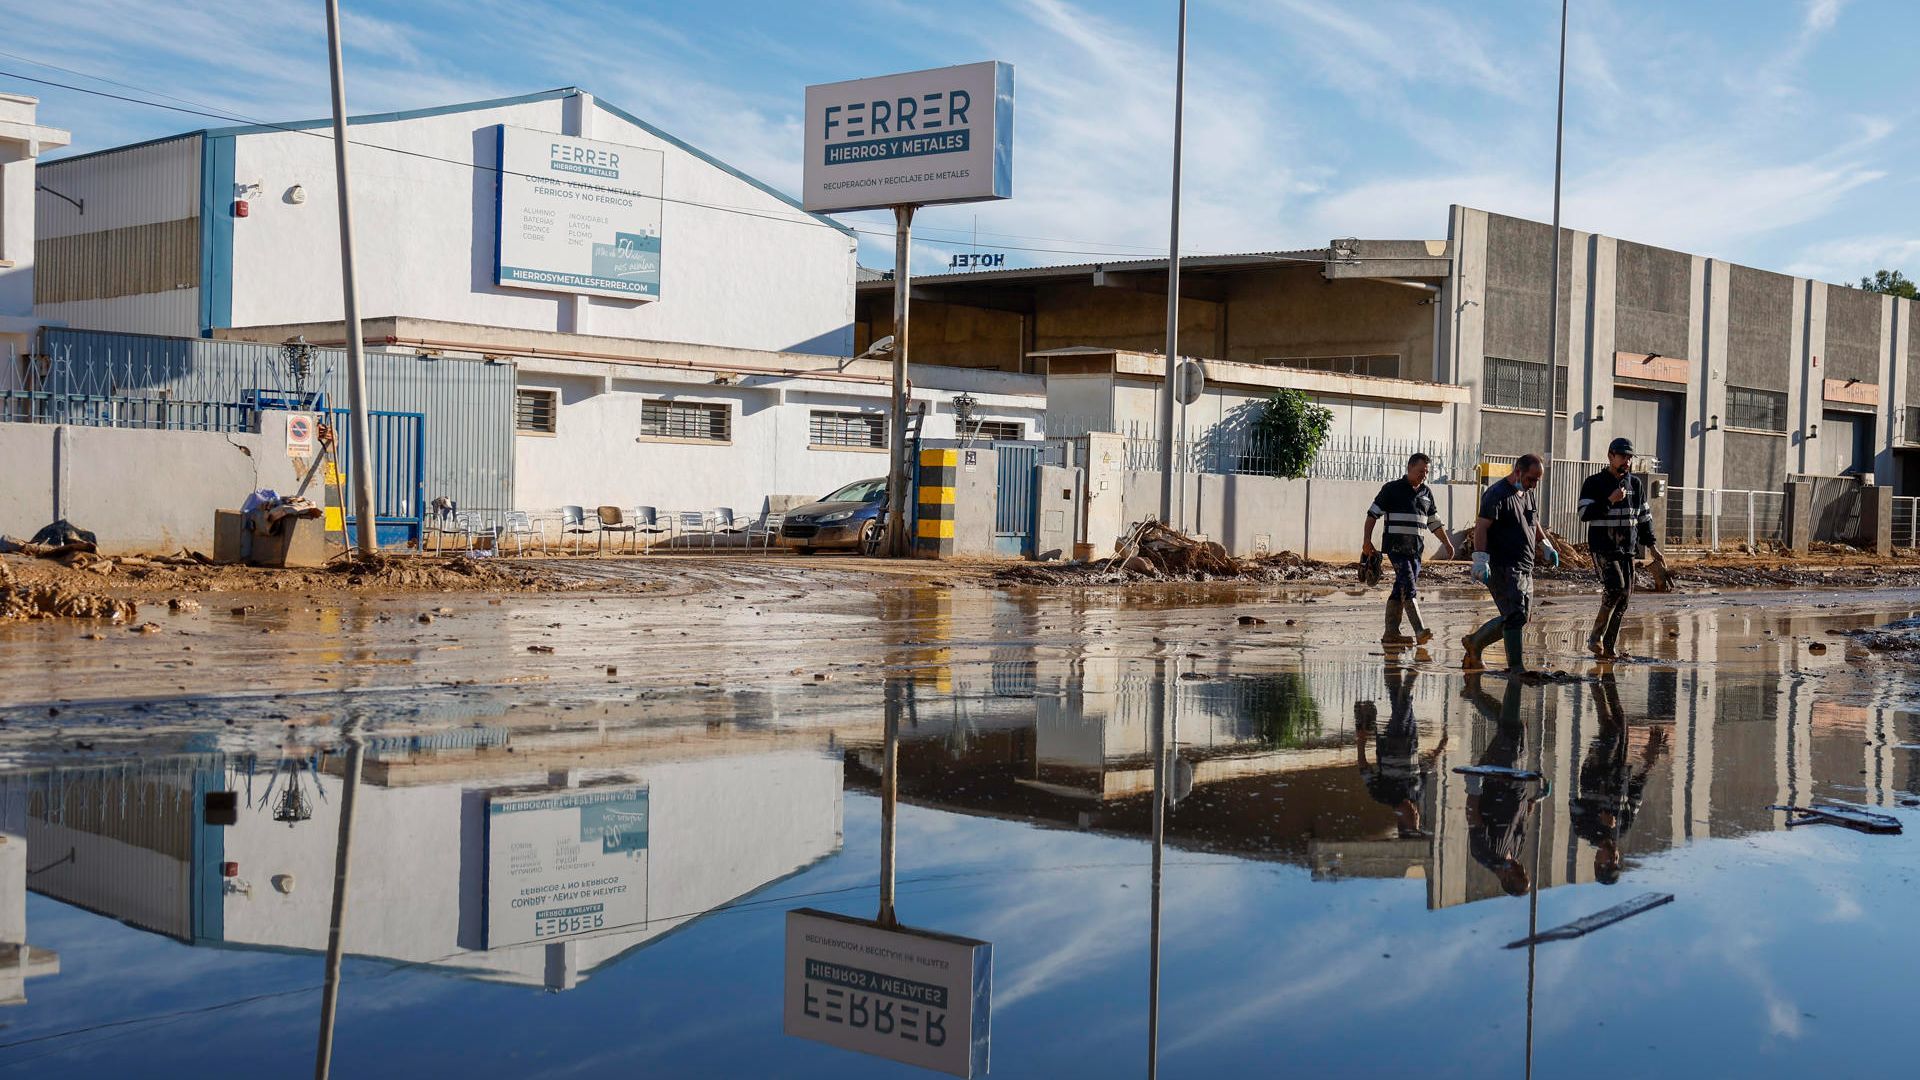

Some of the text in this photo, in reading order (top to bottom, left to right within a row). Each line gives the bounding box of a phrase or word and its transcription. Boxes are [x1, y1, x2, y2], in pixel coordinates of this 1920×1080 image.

[825, 90, 970, 139] FERRER
[831, 135, 963, 161] HIERROS Y METALES
[551, 144, 619, 168] FERRER
[554, 162, 582, 172] HIERROS
[589, 168, 616, 177] METALES
[526, 174, 560, 186] COMPRA
[885, 174, 921, 184] RECICLAJE
[924, 172, 934, 180] DE
[936, 170, 969, 179] METALES
[575, 192, 580, 200] Y
[582, 193, 594, 201] NO
[524, 206, 556, 217] ALUMINIO
[568, 213, 608, 224] INOXIDABLE
[523, 224, 550, 233] BRONCE
[522, 232, 544, 241] COBRE
[568, 230, 592, 239] PLOMO
[568, 238, 584, 246] ZINC
[513, 270, 648, 291] HIERROSYMETALESFERRER.COM
